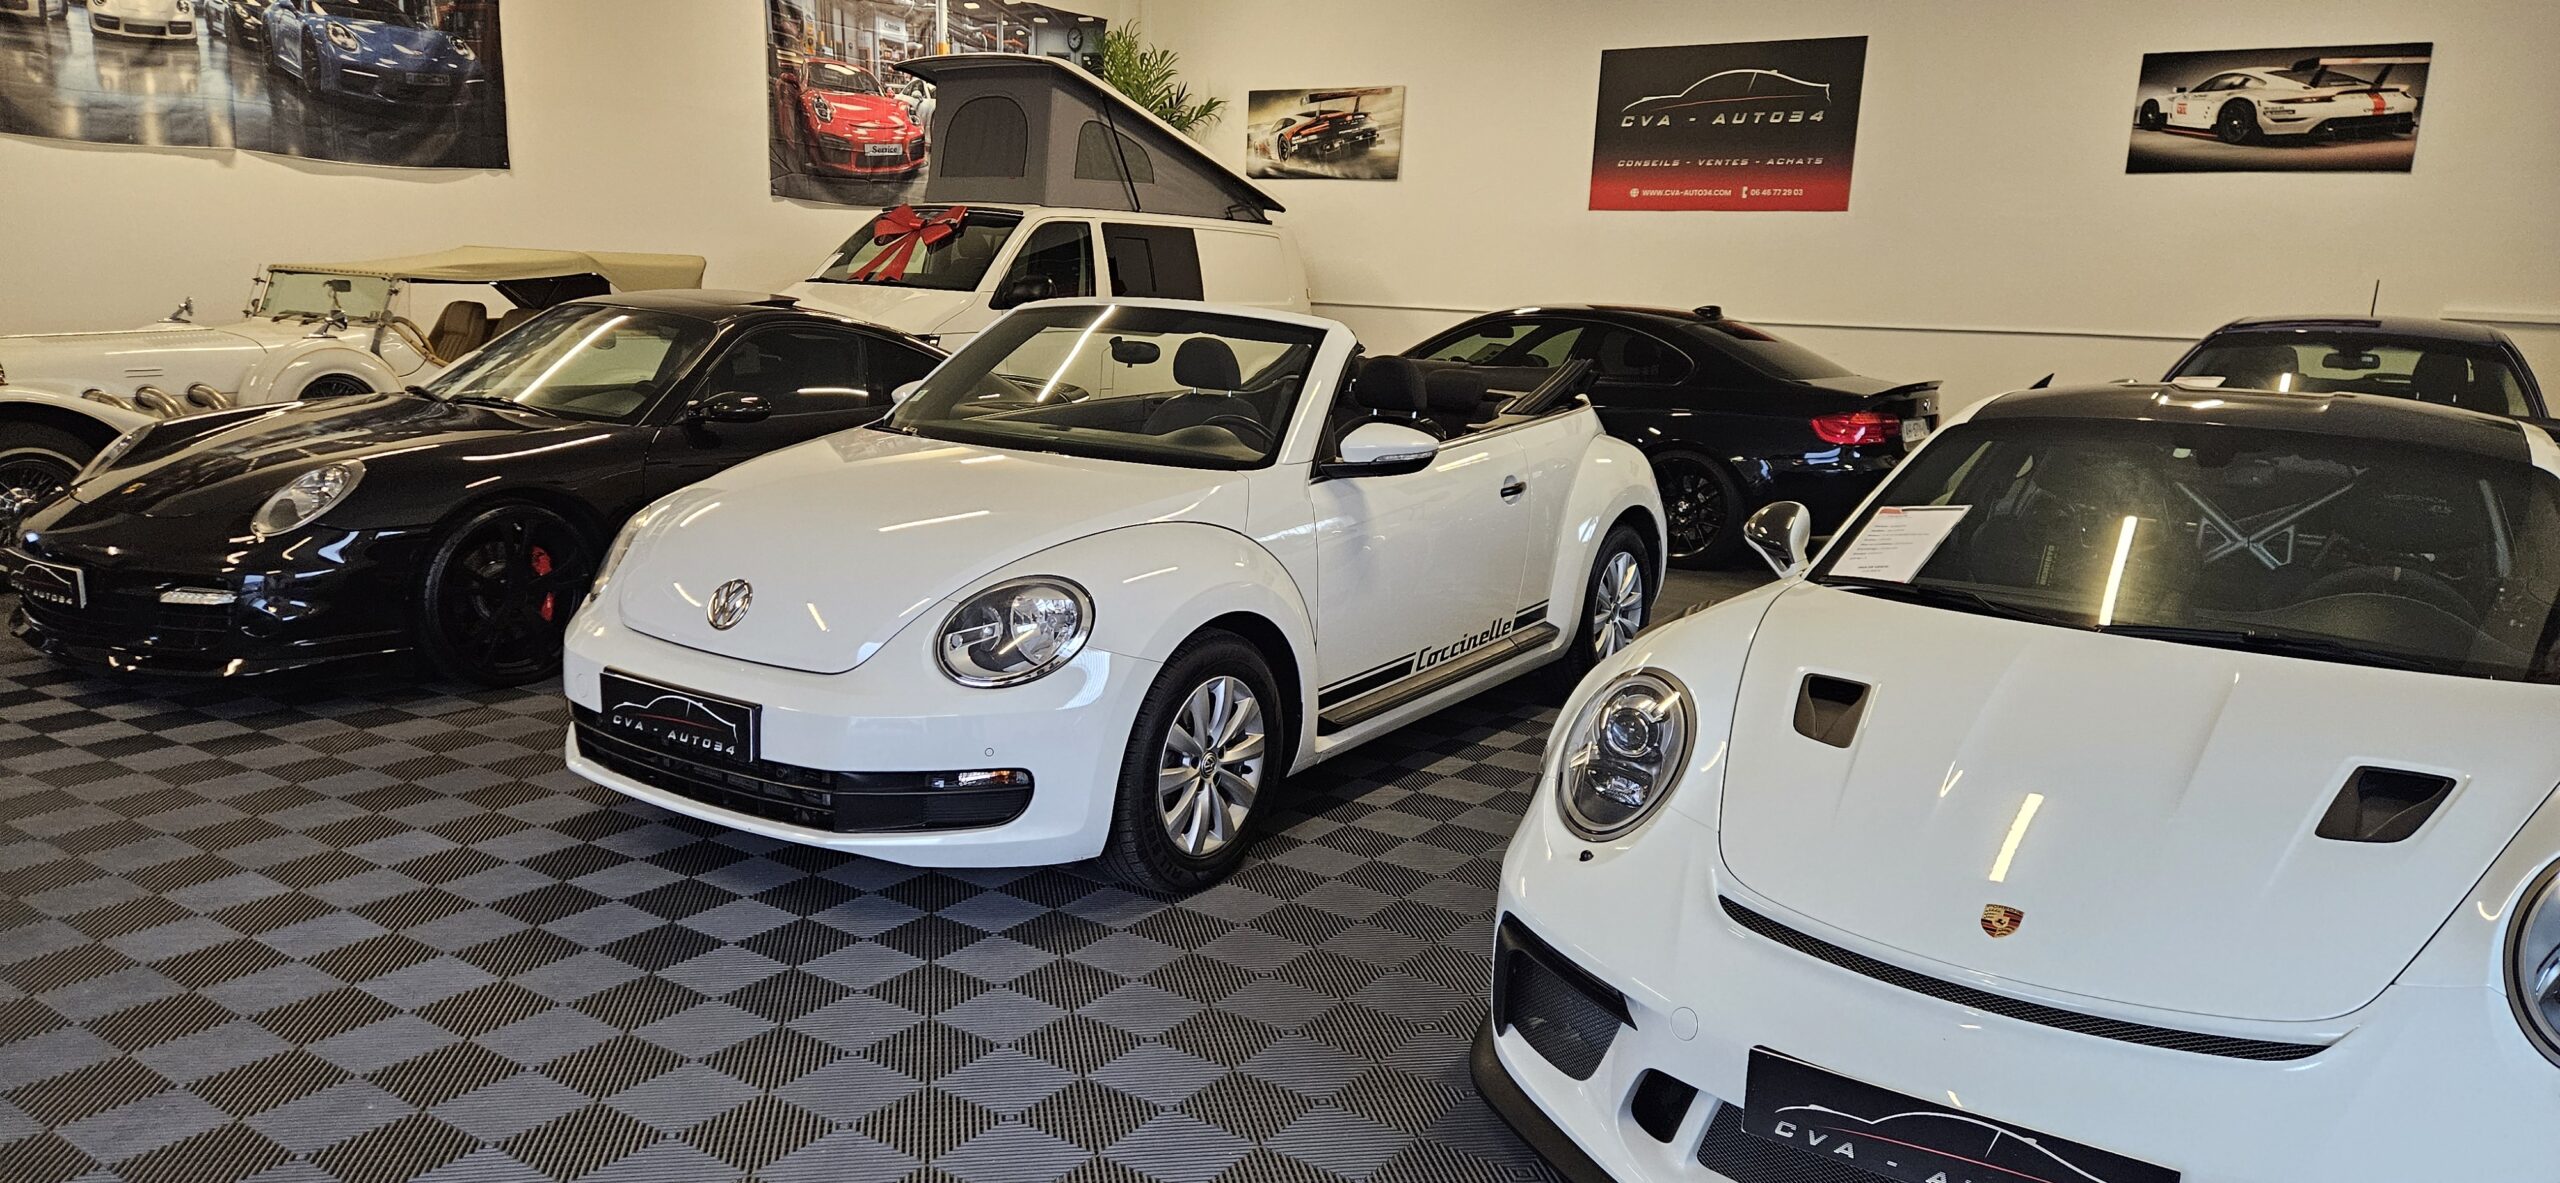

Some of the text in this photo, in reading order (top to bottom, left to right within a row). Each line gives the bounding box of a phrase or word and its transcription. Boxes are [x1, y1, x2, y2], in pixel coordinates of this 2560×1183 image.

[1621, 114, 1671, 127] CVA
[1712, 111, 1824, 126] AUTO34
[1617, 159, 1680, 167] CONSEILS
[1698, 158, 1749, 166] VENTES
[1766, 157, 1824, 165] ACHATS
[1641, 188, 1732, 196] WWW.CVA-AUTO34.COM
[1415, 617, 1513, 672] Coccinelle
[612, 714, 644, 731] CVA
[668, 730, 736, 756] AUTO34
[1774, 1120, 1855, 1159] CVA
